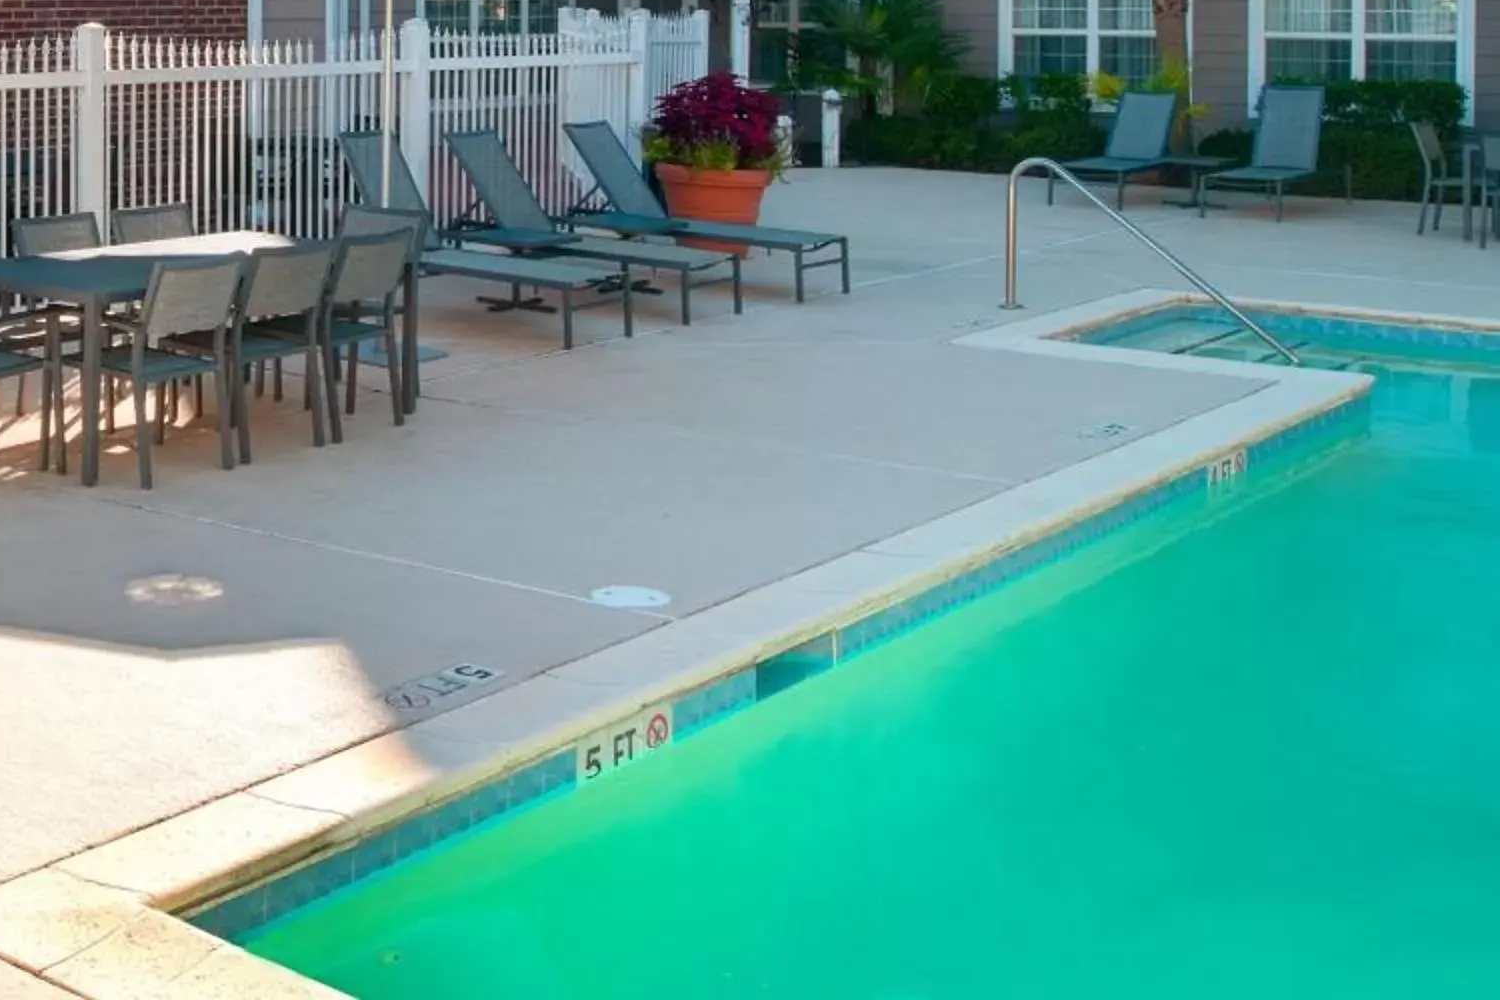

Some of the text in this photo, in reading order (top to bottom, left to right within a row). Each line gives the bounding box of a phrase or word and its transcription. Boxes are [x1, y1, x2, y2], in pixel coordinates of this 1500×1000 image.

[418, 664, 493, 696] 5 FT
[585, 728, 637, 779] 5 FT
